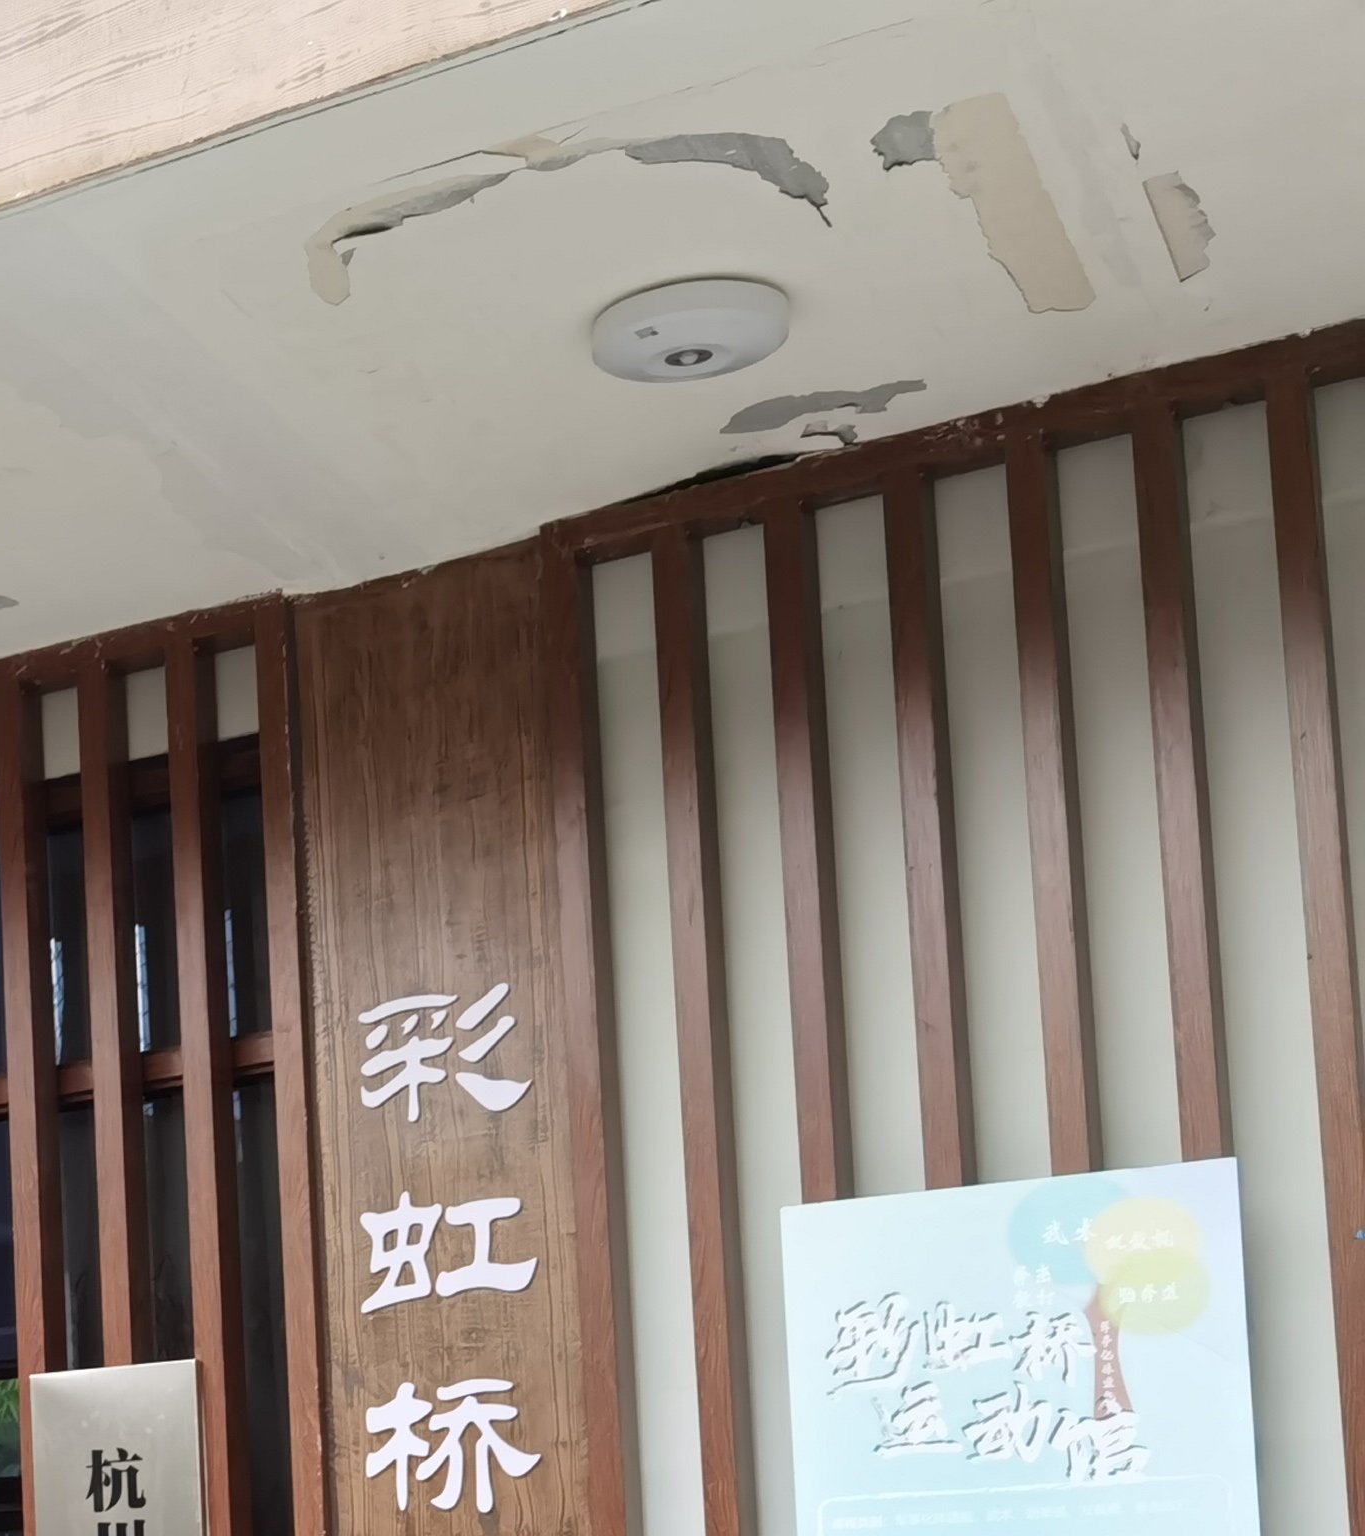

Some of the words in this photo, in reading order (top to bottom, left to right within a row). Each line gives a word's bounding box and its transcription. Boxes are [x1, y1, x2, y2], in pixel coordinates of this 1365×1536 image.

[826, 1291, 1095, 1395] 彩虹桥
[872, 1381, 1152, 1484] 运动馆
